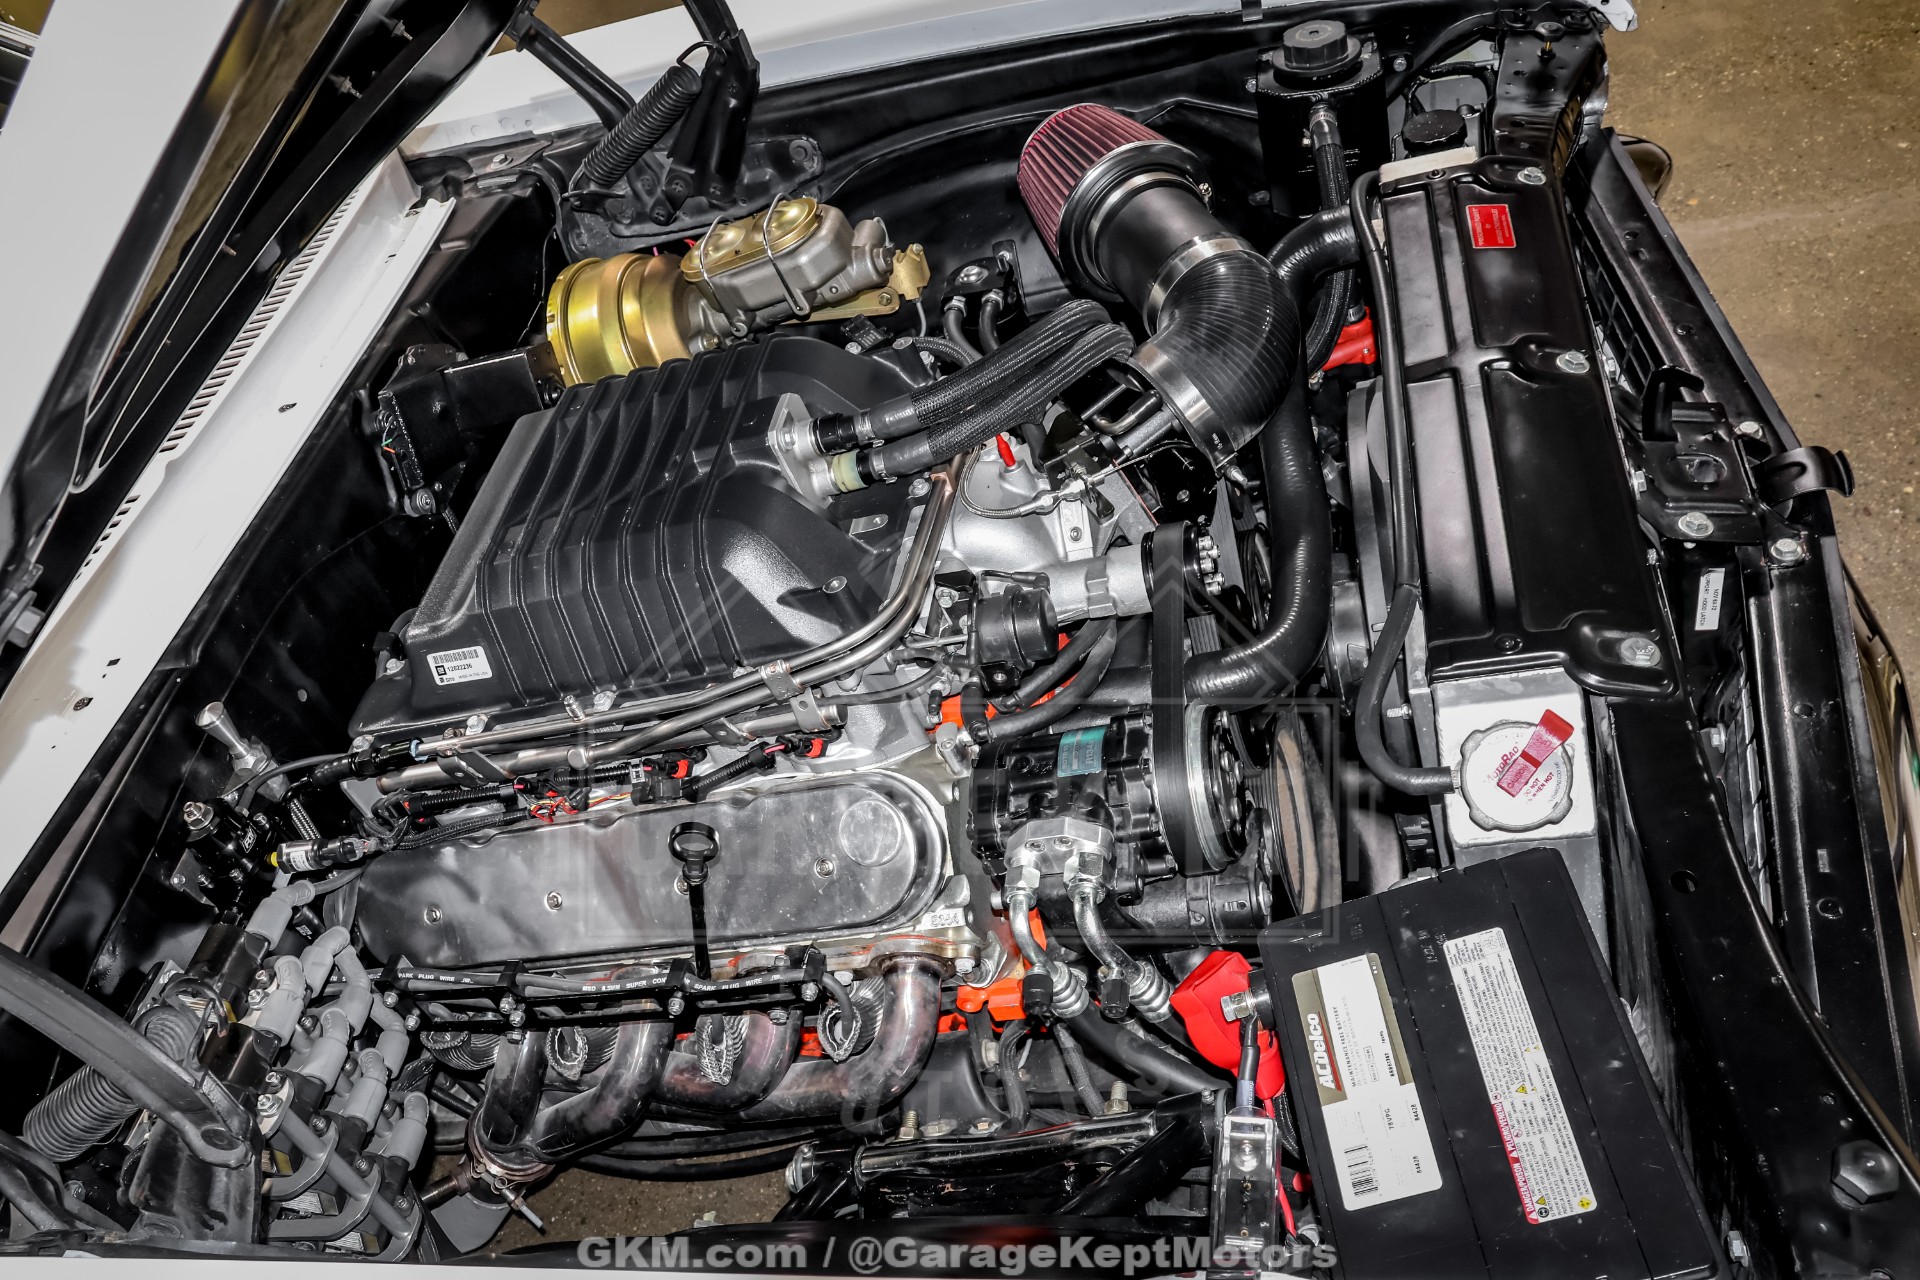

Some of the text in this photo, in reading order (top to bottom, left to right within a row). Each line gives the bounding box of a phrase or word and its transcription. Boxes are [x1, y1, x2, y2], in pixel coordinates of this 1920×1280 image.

[626, 980, 647, 989] SUPER
[746, 977, 762, 986] WIRE
[1308, 1013, 1335, 1090] ACDelco
[1384, 1107, 1394, 1130] 78VPG
[1493, 1102, 1516, 1151] PELIGRO/VENENO
[1512, 1162, 1534, 1211] DANGER/POISON
